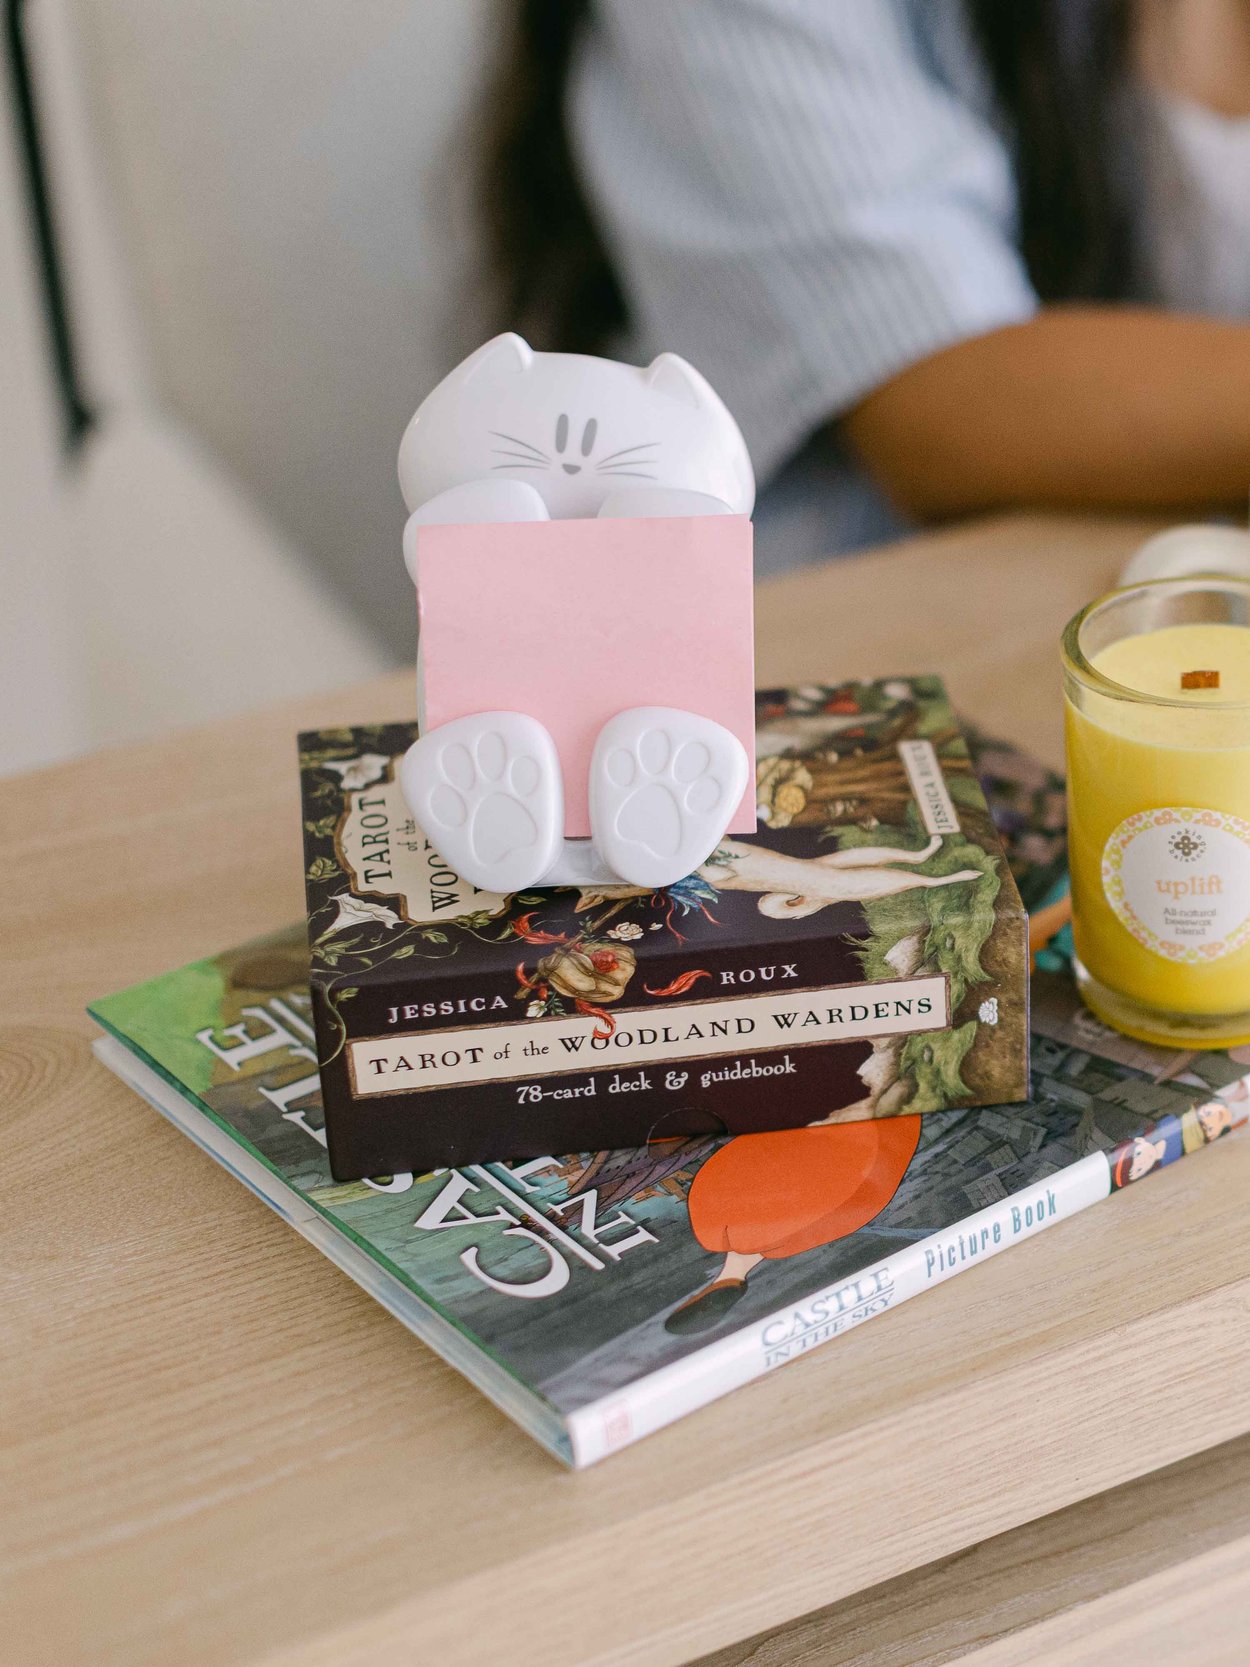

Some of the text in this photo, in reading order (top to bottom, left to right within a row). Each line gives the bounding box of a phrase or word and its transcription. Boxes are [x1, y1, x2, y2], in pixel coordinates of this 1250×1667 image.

[358, 796, 393, 884] TAROT
[397, 840, 418, 852] of
[1155, 874, 1223, 901] uplift
[1165, 918, 1212, 927] beeswax
[1175, 928, 1207, 936] blend
[387, 963, 799, 1024] JESSICA ROUX
[369, 997, 933, 1076] TAROT of the WOODLAND WARDENS
[516, 1054, 797, 1105] 78-card deck & guidebook
[924, 1189, 1058, 1278] Picture Book
[761, 1266, 895, 1347] CASTLE
[765, 1292, 894, 1368] IN THE SKY
